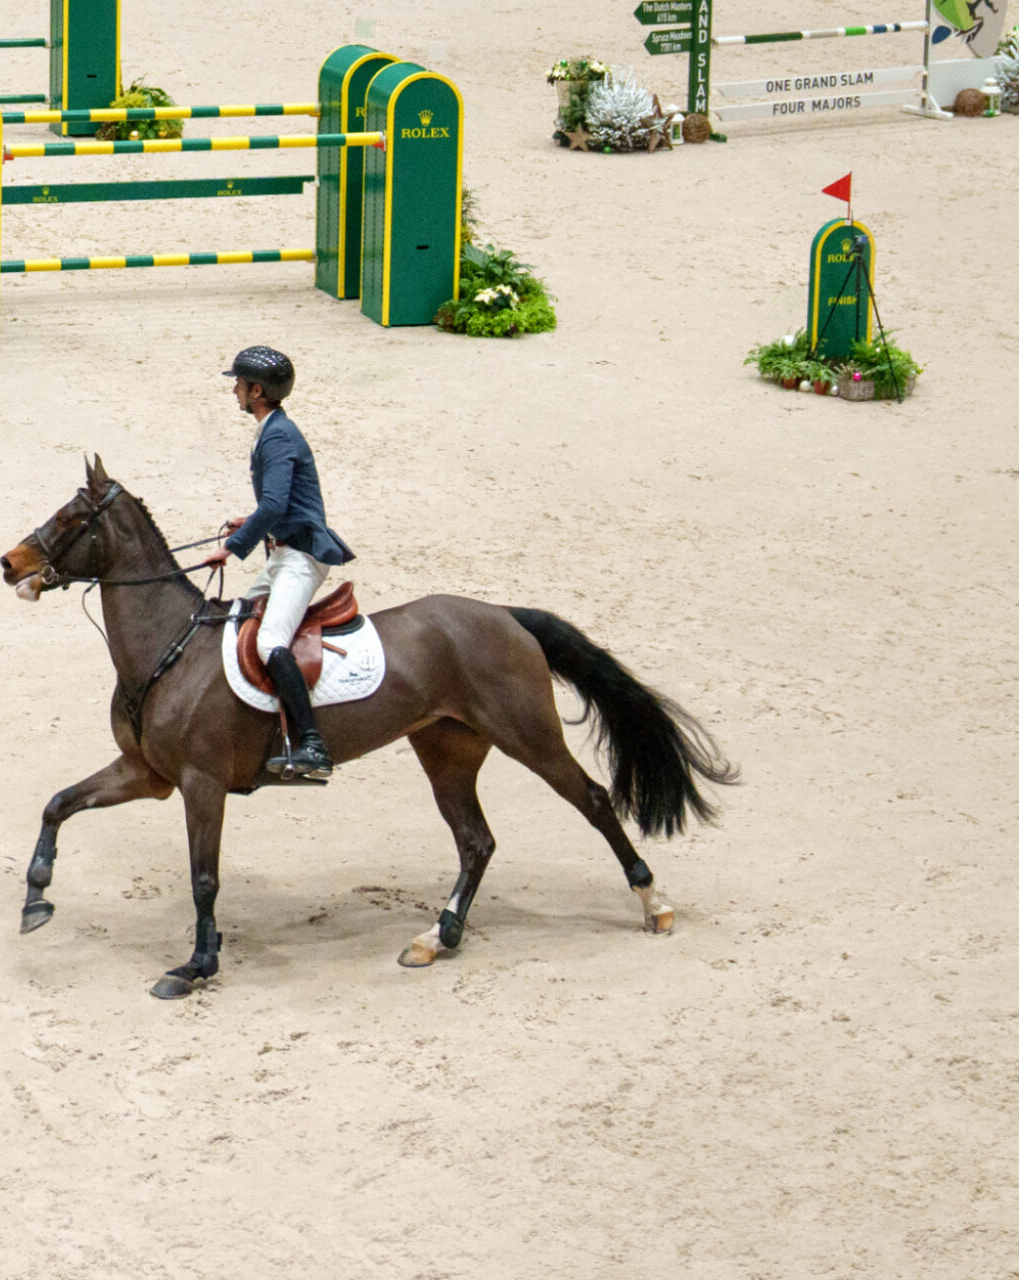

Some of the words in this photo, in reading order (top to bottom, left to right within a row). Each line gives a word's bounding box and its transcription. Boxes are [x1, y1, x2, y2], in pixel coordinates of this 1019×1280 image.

[695, 53, 707, 113] SLAM
[766, 79, 791, 93] ONE
[795, 75, 837, 90] GRAND
[840, 72, 874, 86] SLAM
[772, 101, 805, 115] FOUR
[812, 96, 861, 112] MAJORS
[401, 127, 450, 139] ROLEX
[217, 189, 242, 197] ROLEX
[828, 295, 858, 306] FNISH
